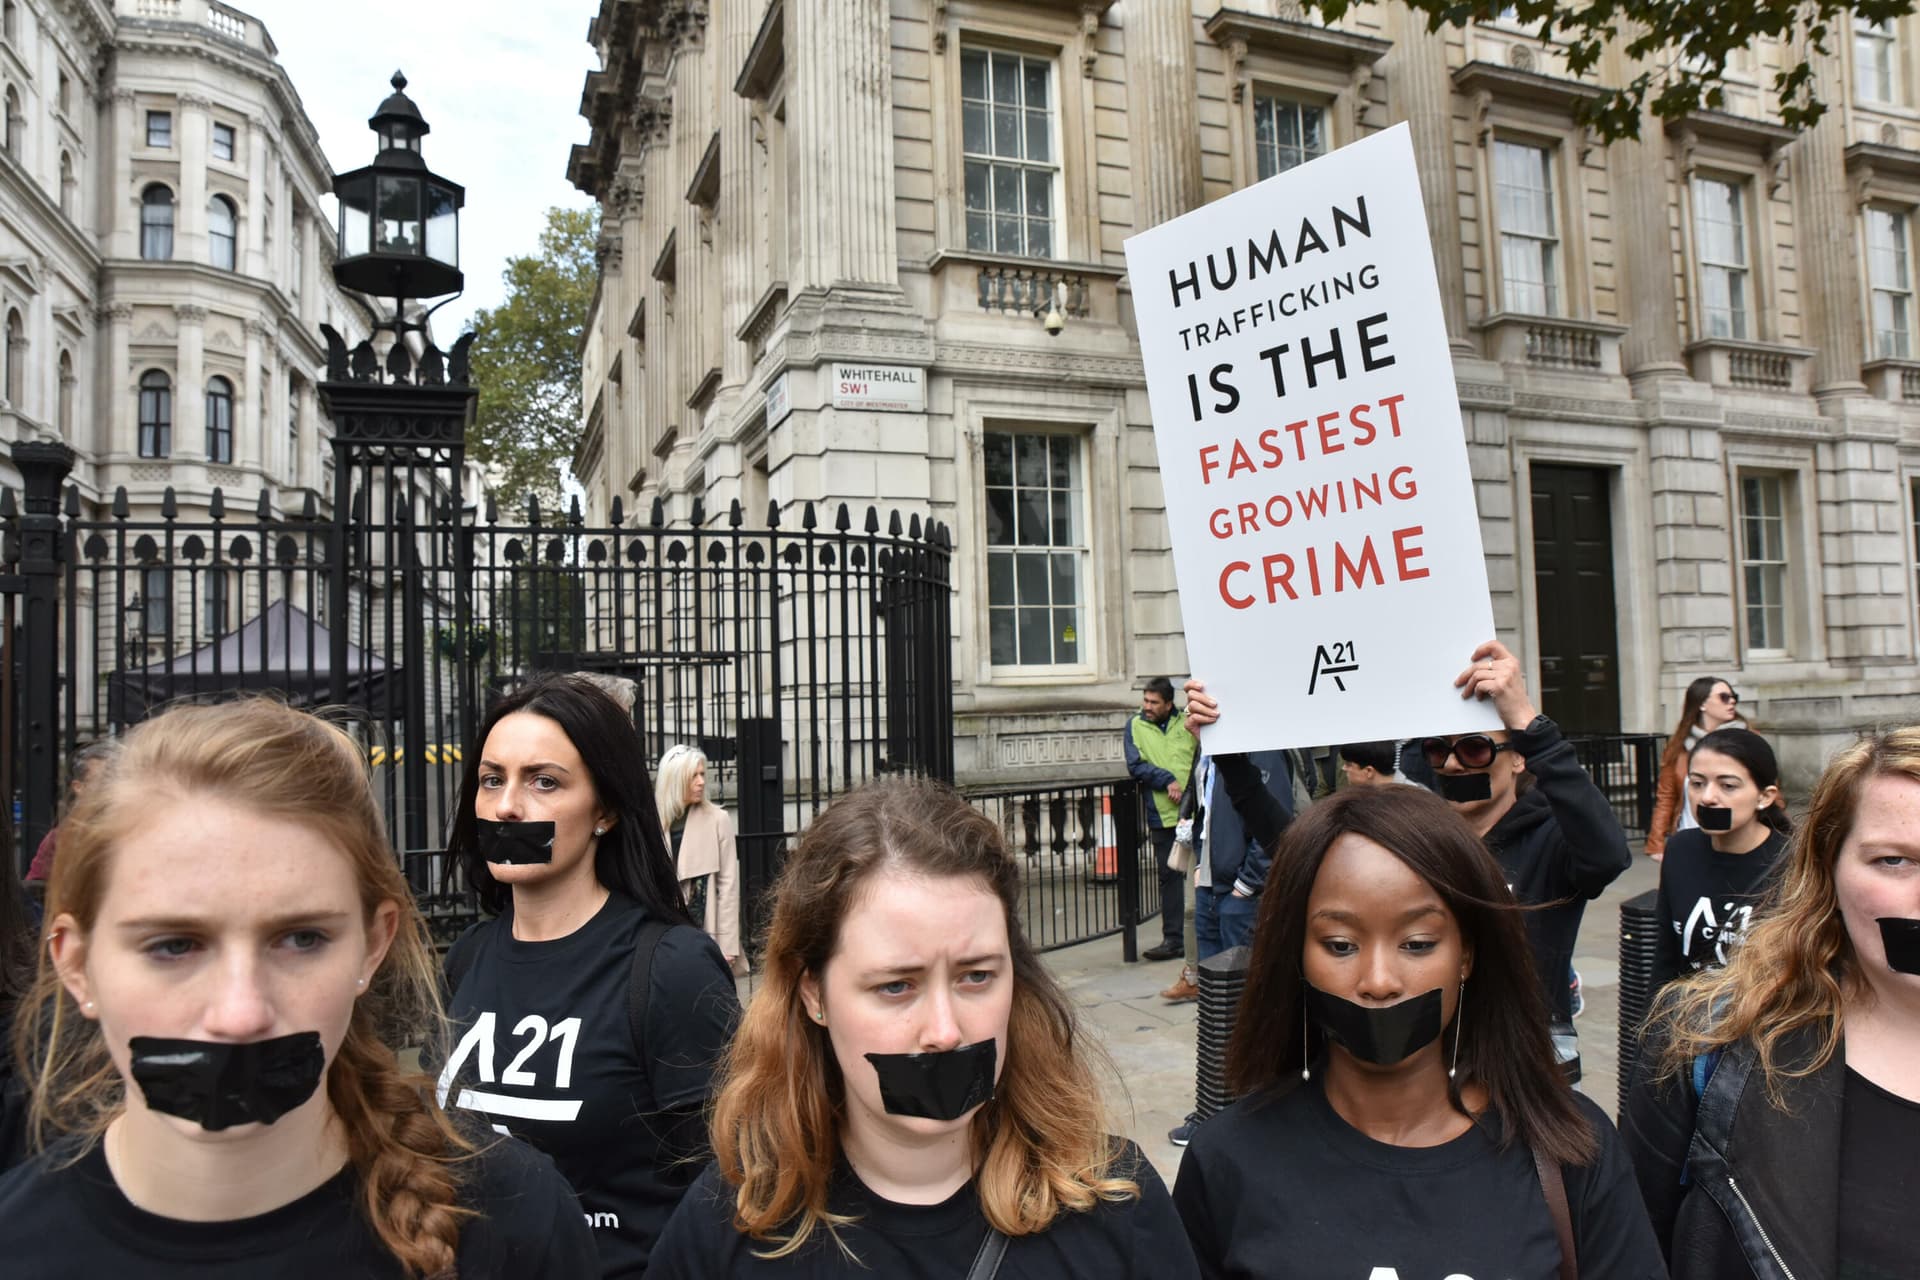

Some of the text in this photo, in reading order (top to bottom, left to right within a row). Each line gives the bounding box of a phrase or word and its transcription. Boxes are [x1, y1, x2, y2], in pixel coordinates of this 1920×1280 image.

[1168, 195, 1373, 308] HUMAN
[1178, 264, 1381, 351] TRAFFICKING
[840, 368, 916, 384] WHITEHALL
[840, 383, 868, 395] SW1
[1187, 311, 1397, 422] IS THE
[1199, 394, 1406, 486] FASTEST
[1209, 465, 1419, 541] GROWING
[1218, 525, 1431, 611] CRIME
[1307, 640, 1360, 696] A21
[435, 1011, 584, 1137] A21
